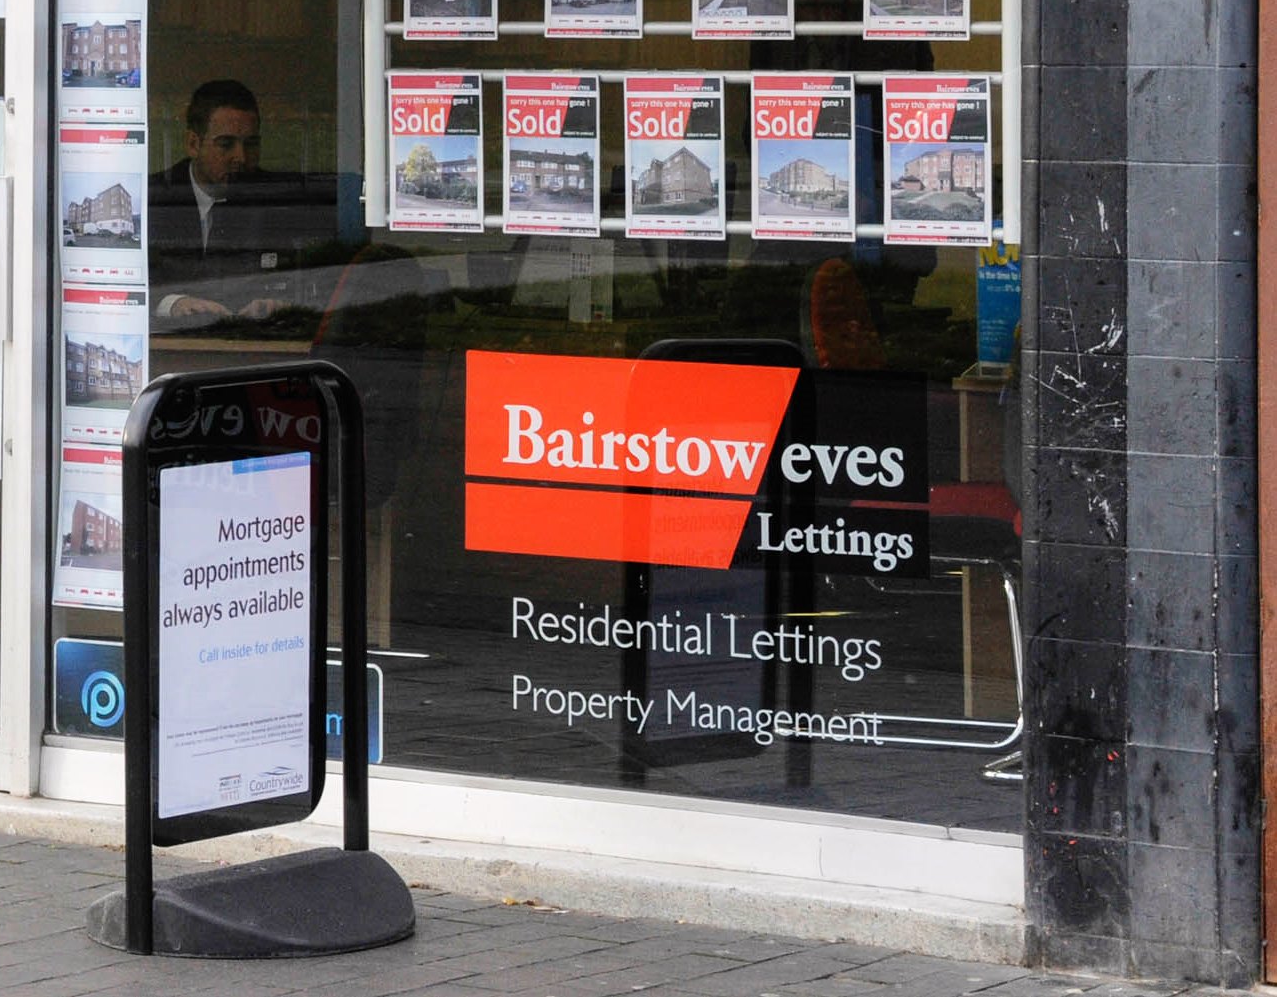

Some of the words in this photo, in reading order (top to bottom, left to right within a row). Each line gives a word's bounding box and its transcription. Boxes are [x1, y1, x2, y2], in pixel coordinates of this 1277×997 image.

[393, 107, 445, 133] Sold
[508, 108, 561, 135] Sold
[629, 110, 684, 137] Sold
[756, 109, 813, 137] Sold
[888, 112, 948, 140] Sold
[502, 404, 765, 481] Bairstow
[781, 441, 904, 488] eves
[218, 514, 305, 543] Mortgage
[757, 512, 914, 572] Lettings
[183, 550, 305, 590] appointments
[163, 602, 222, 629] always
[228, 587, 305, 619] available
[199, 648, 219, 664] Call
[222, 643, 252, 661] inside
[254, 641, 269, 655] for
[271, 635, 305, 653] details
[512, 597, 712, 656] Residential
[727, 612, 883, 682] Lettings
[512, 675, 655, 735] Property
[667, 690, 885, 746] Management
[249, 772, 304, 792] Countrywide
